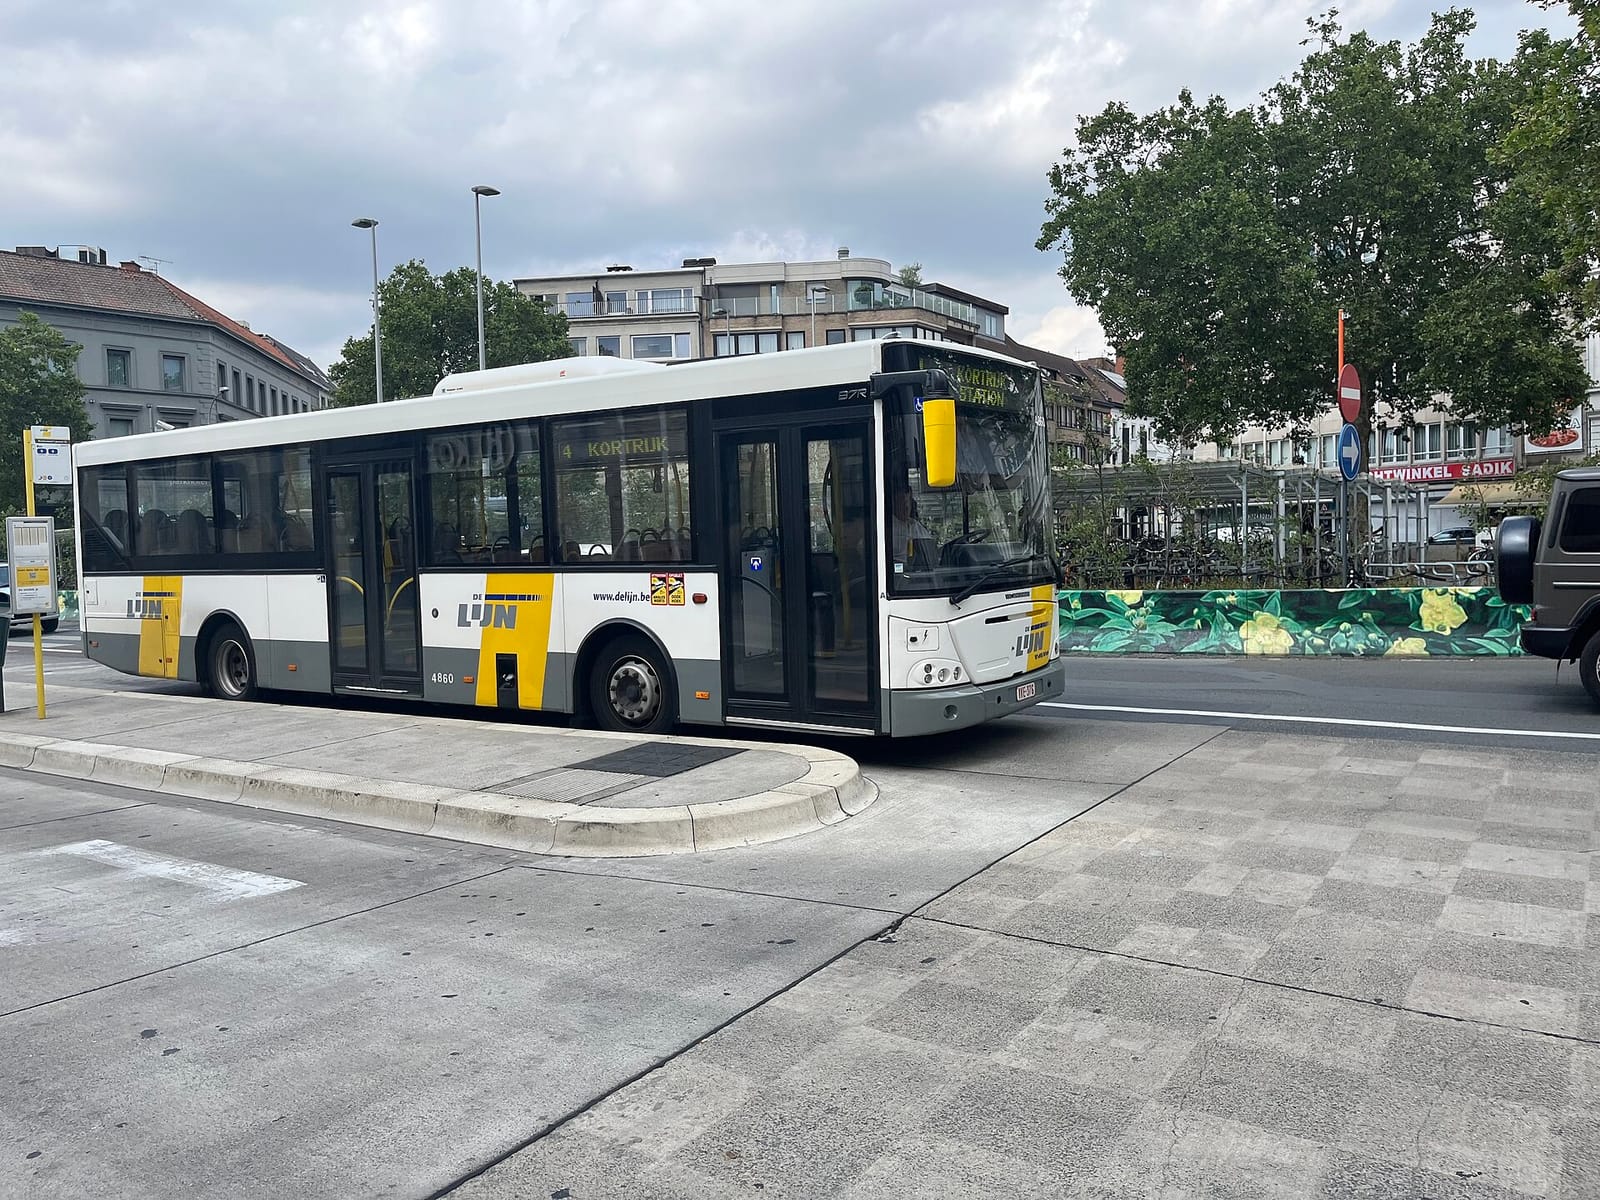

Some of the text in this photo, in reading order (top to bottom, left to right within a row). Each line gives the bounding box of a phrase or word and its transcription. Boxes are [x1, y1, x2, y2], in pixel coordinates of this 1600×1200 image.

[960, 385, 1005, 407] STATION
[563, 437, 669, 459] 4 KORTRIJK
[1461, 461, 1513, 477] SADIK
[472, 593, 483, 601] DE
[593, 591, 650, 604] www.delijn.be
[457, 603, 518, 630] LIJN
[1015, 630, 1045, 657] LIJN
[431, 672, 454, 684] 4860
